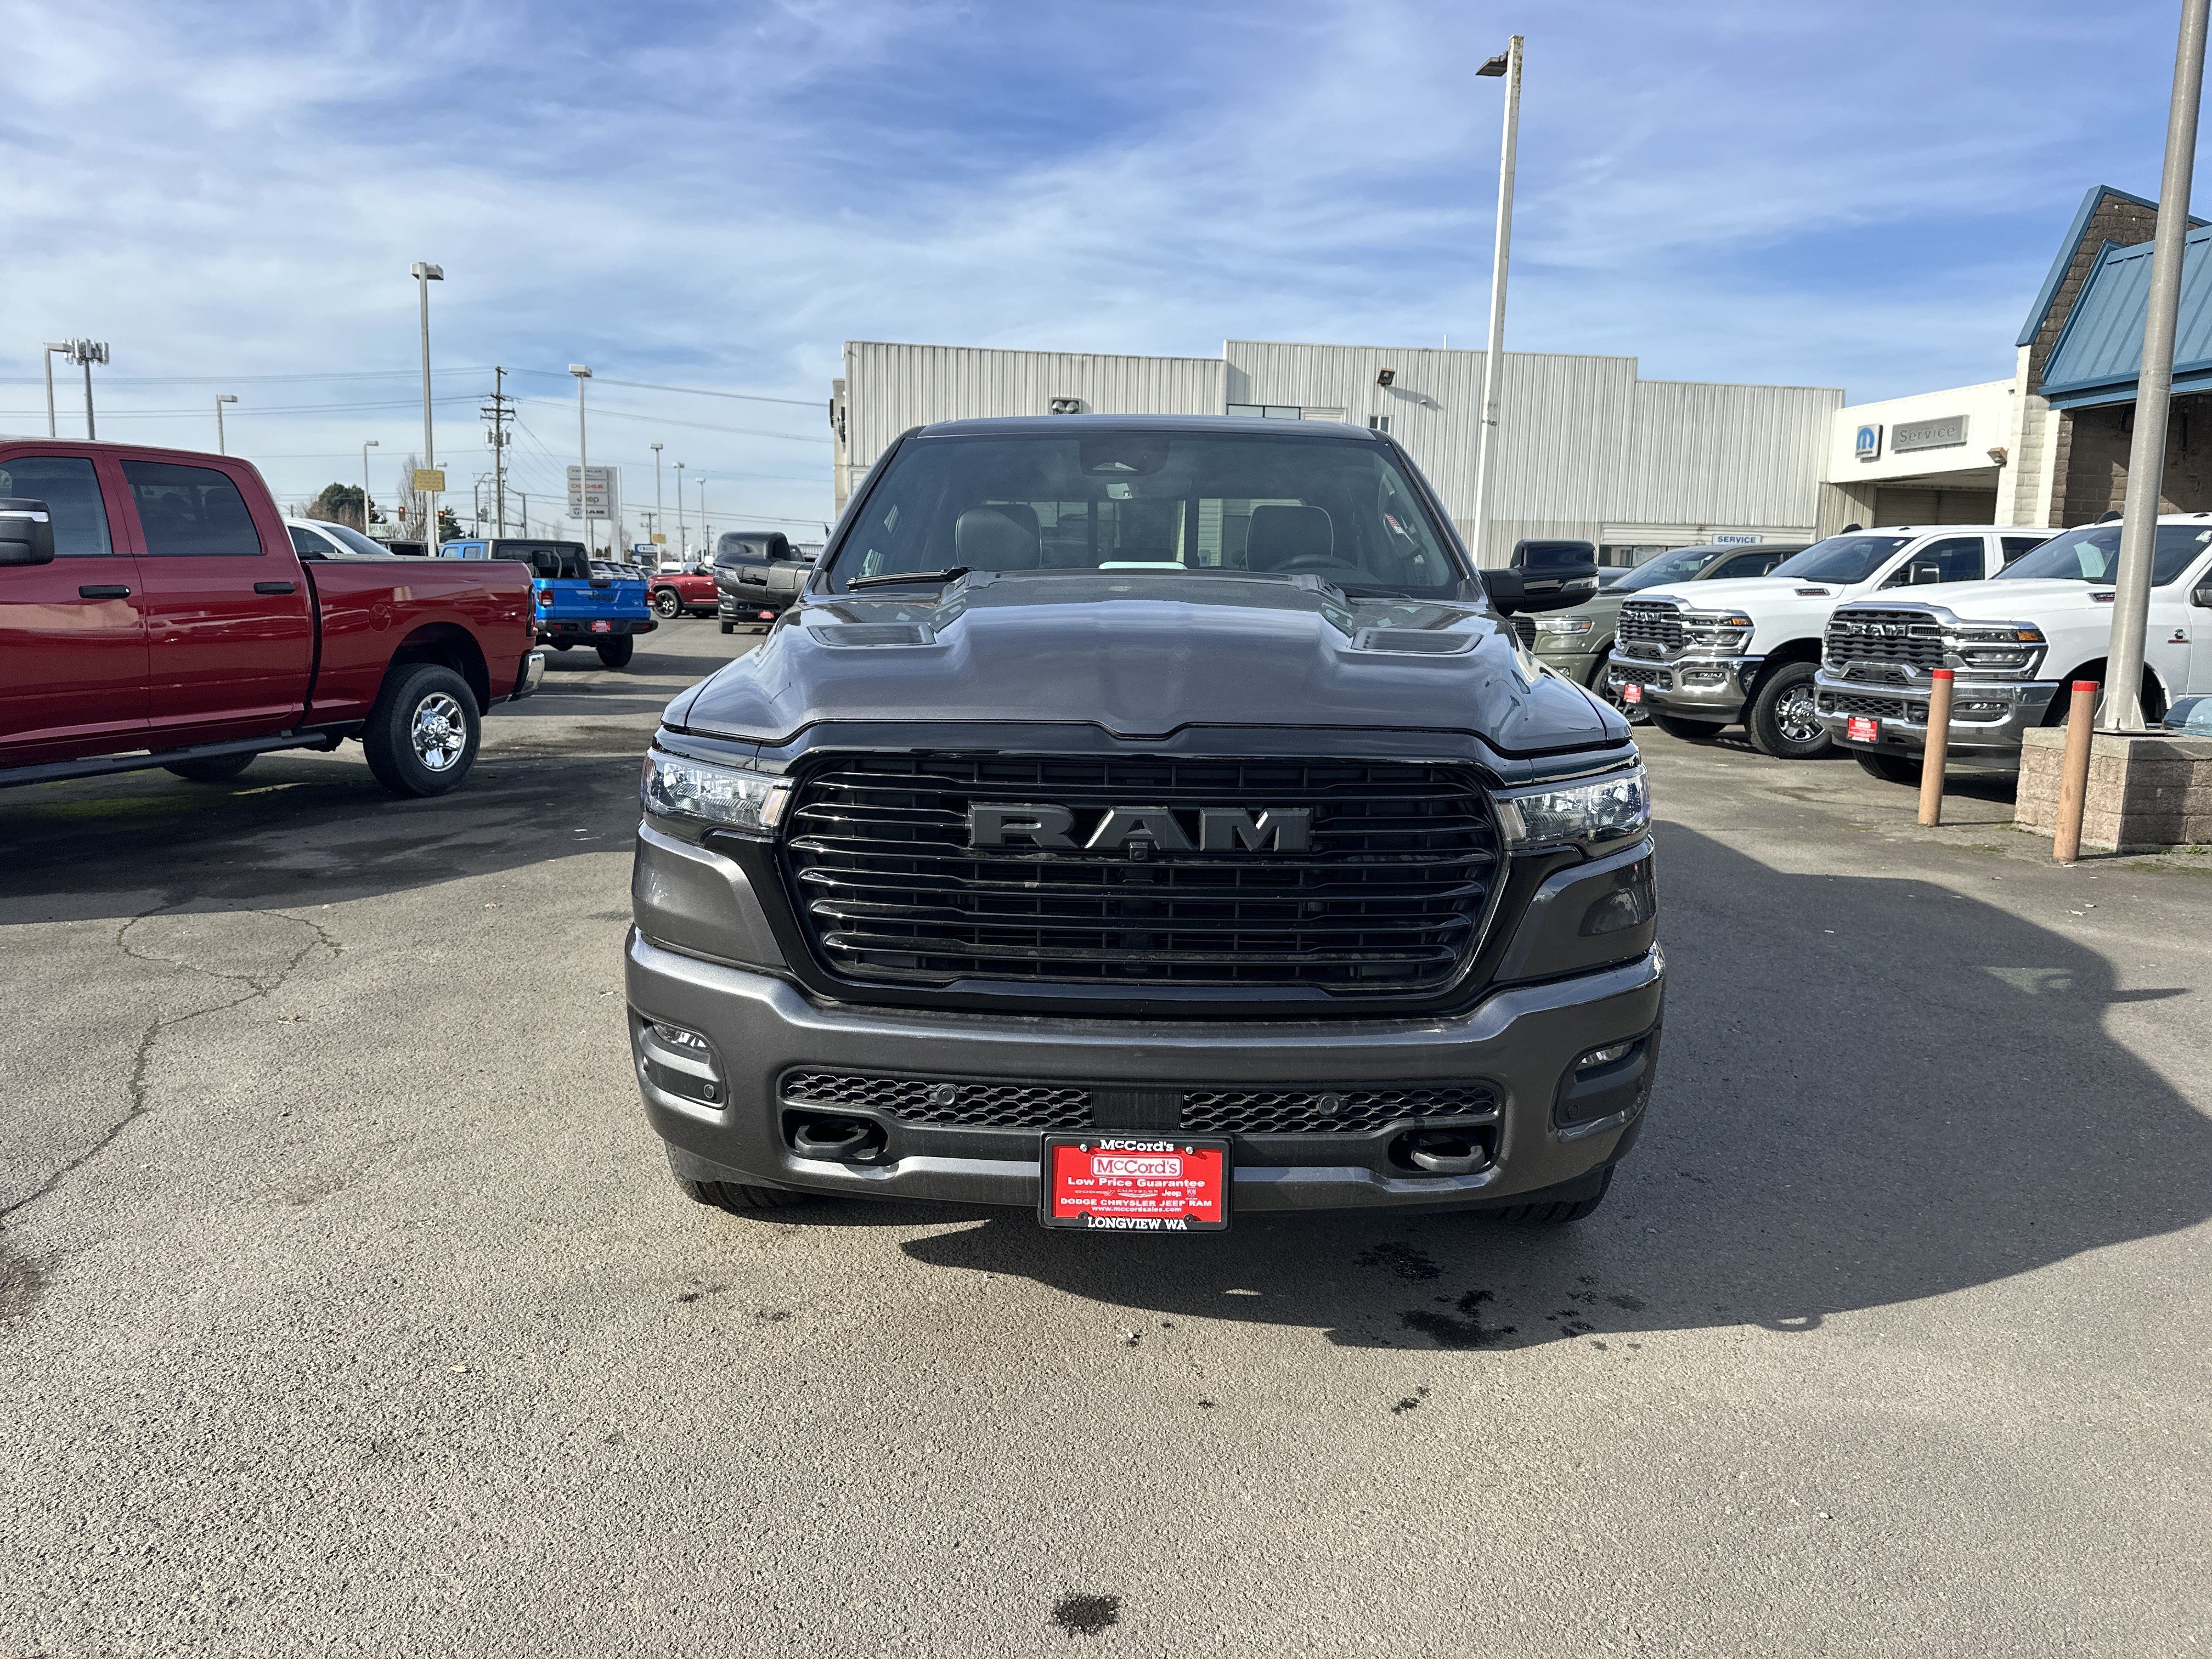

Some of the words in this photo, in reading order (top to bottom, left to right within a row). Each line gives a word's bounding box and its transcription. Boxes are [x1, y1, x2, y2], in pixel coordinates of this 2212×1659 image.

[1900, 425, 1955, 443] Service
[577, 494, 600, 504] Jep
[1850, 623, 1906, 636] RAM
[969, 803, 1311, 852] RAM
[1100, 1139, 1174, 1152] McCord's
[1096, 1159, 1177, 1174] McCord's
[1068, 1176, 1095, 1186] Low
[1099, 1177, 1132, 1187] Price
[1136, 1178, 1205, 1187] Guarantee
[1161, 1189, 1182, 1198] Jeep
[1088, 1216, 1161, 1229] LONGVIEW
[1164, 1218, 1188, 1230] WA
